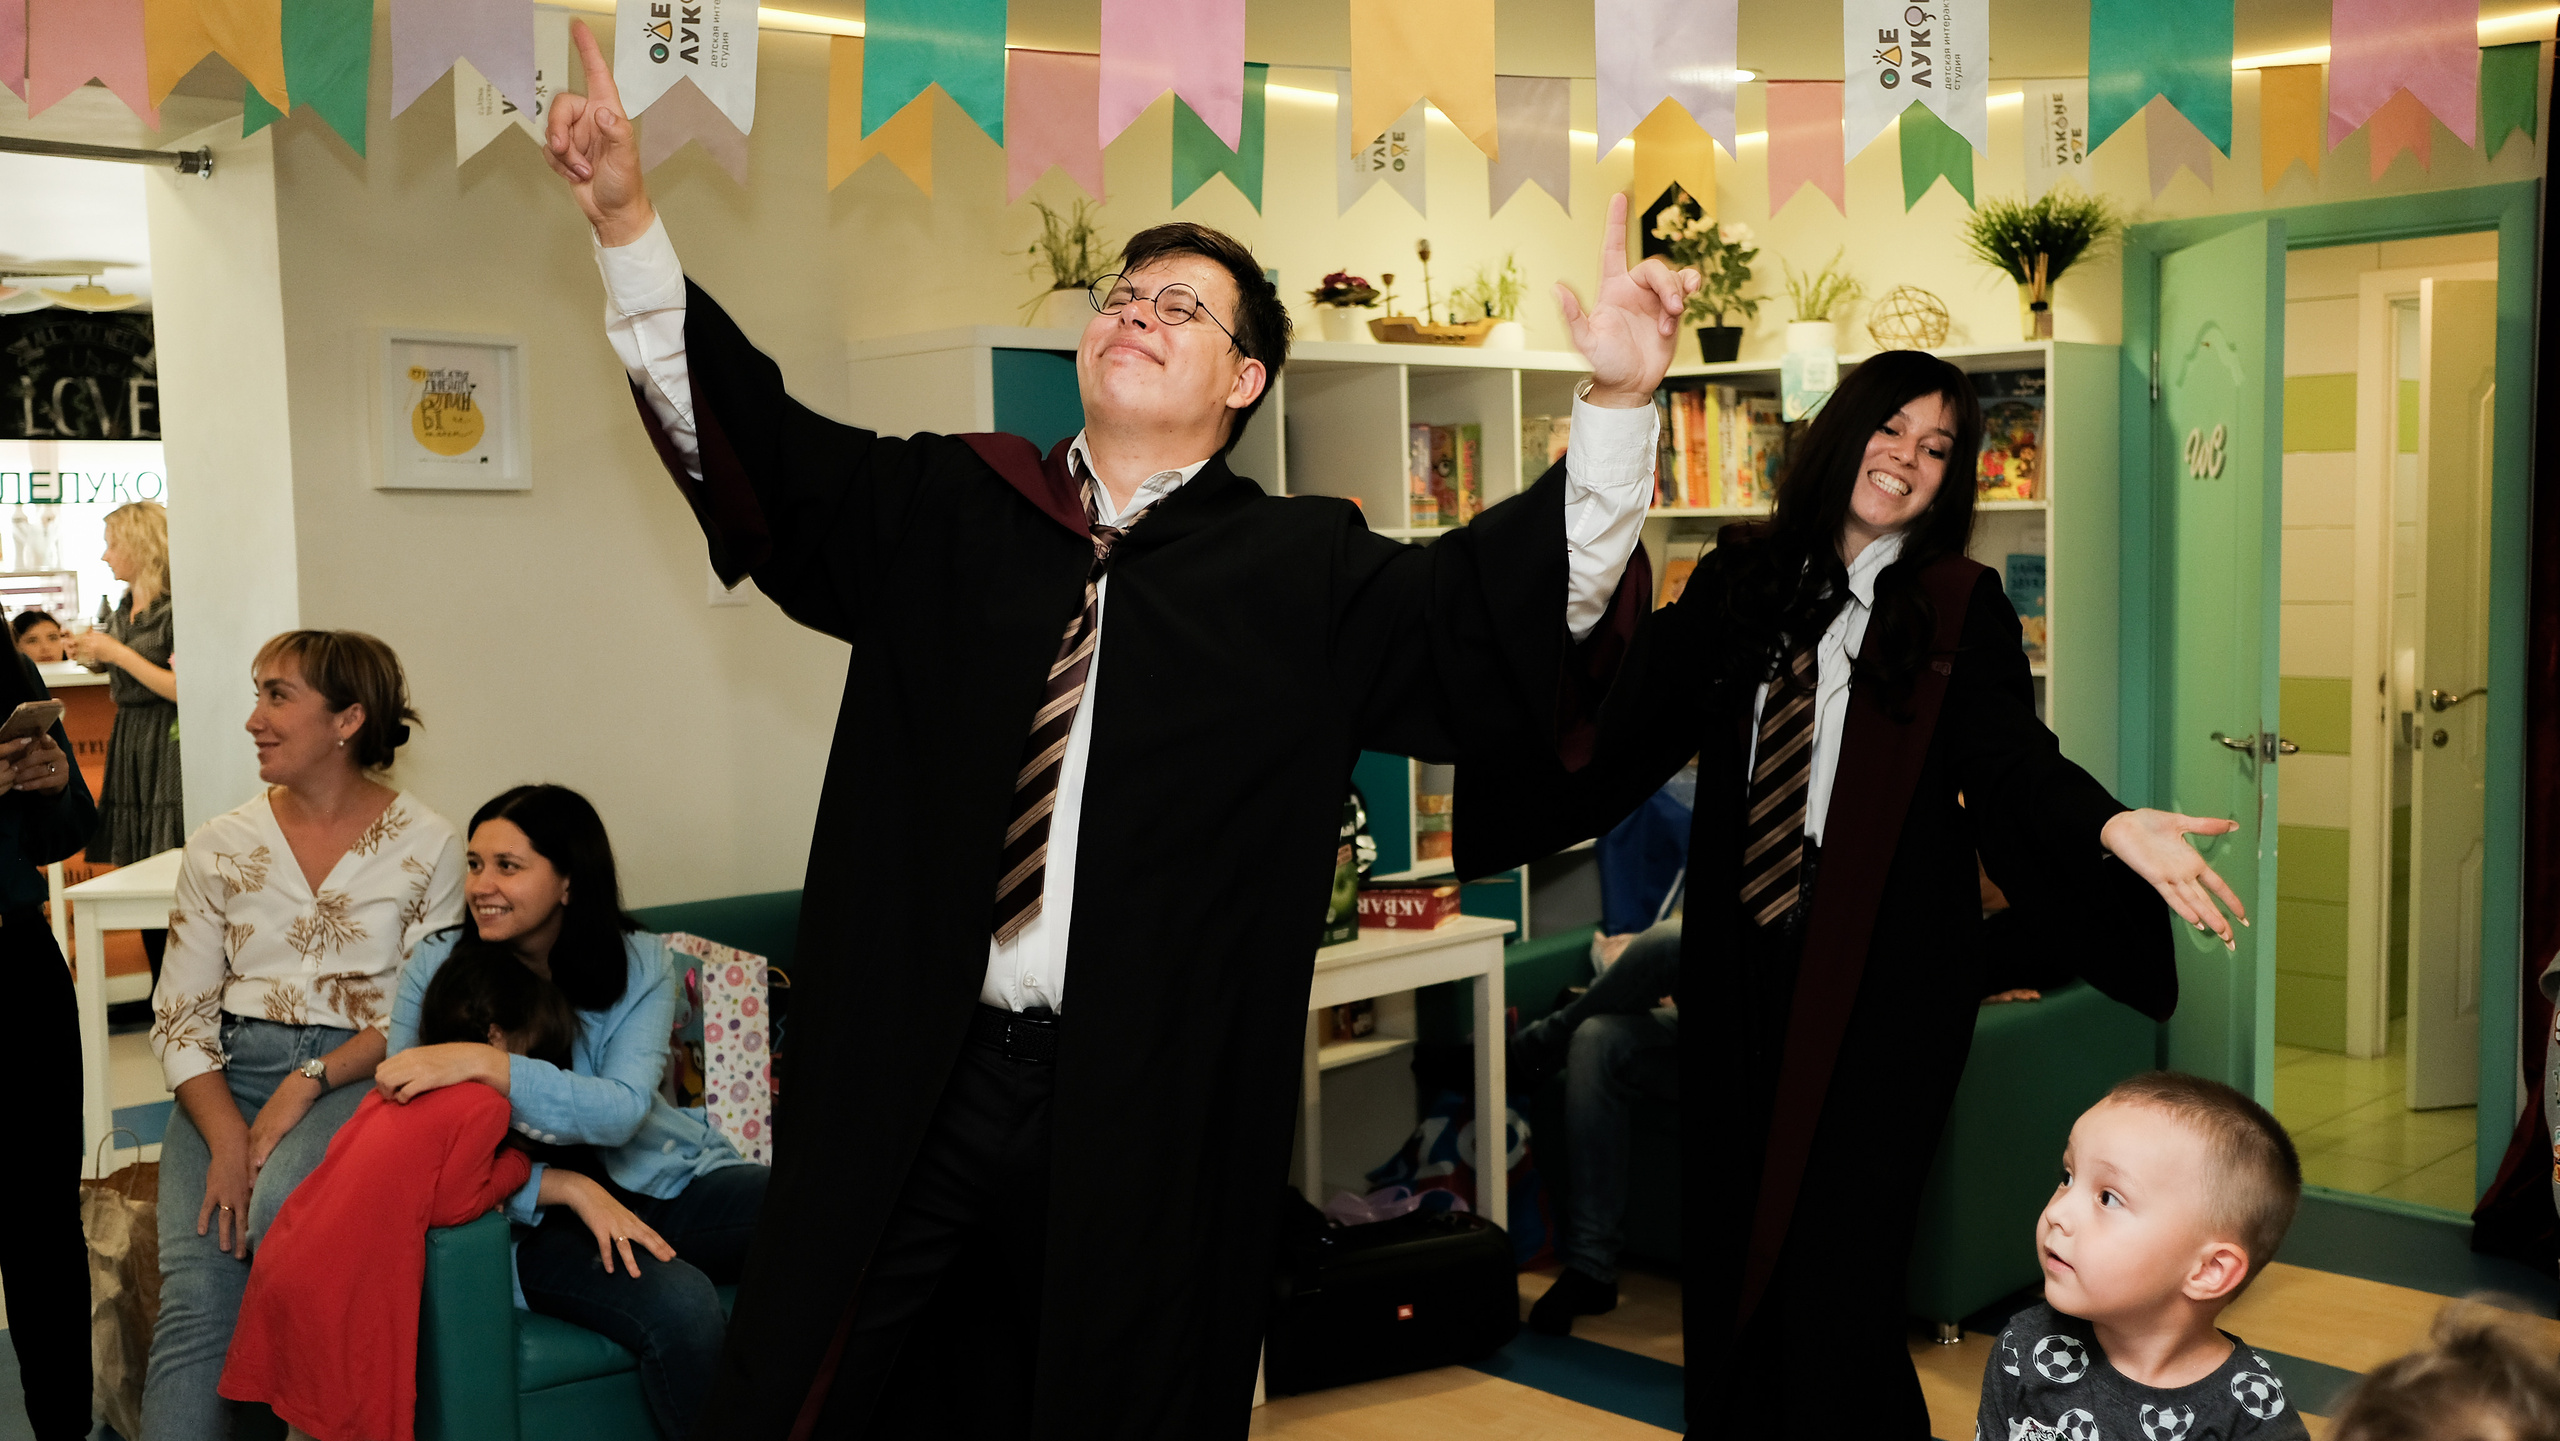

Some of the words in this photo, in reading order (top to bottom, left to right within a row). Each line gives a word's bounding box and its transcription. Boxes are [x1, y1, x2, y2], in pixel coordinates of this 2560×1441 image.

[680, 0, 701, 65] ЛУК
[711, 26, 720, 68] детская
[720, 31, 730, 68] студия
[1904, 0, 1936, 88] ЛУКО
[1944, 48, 1953, 90] детская
[1954, 54, 1963, 91] студия
[20, 375, 161, 437] LOVE
[1357, 896, 1428, 916] AKBAR
